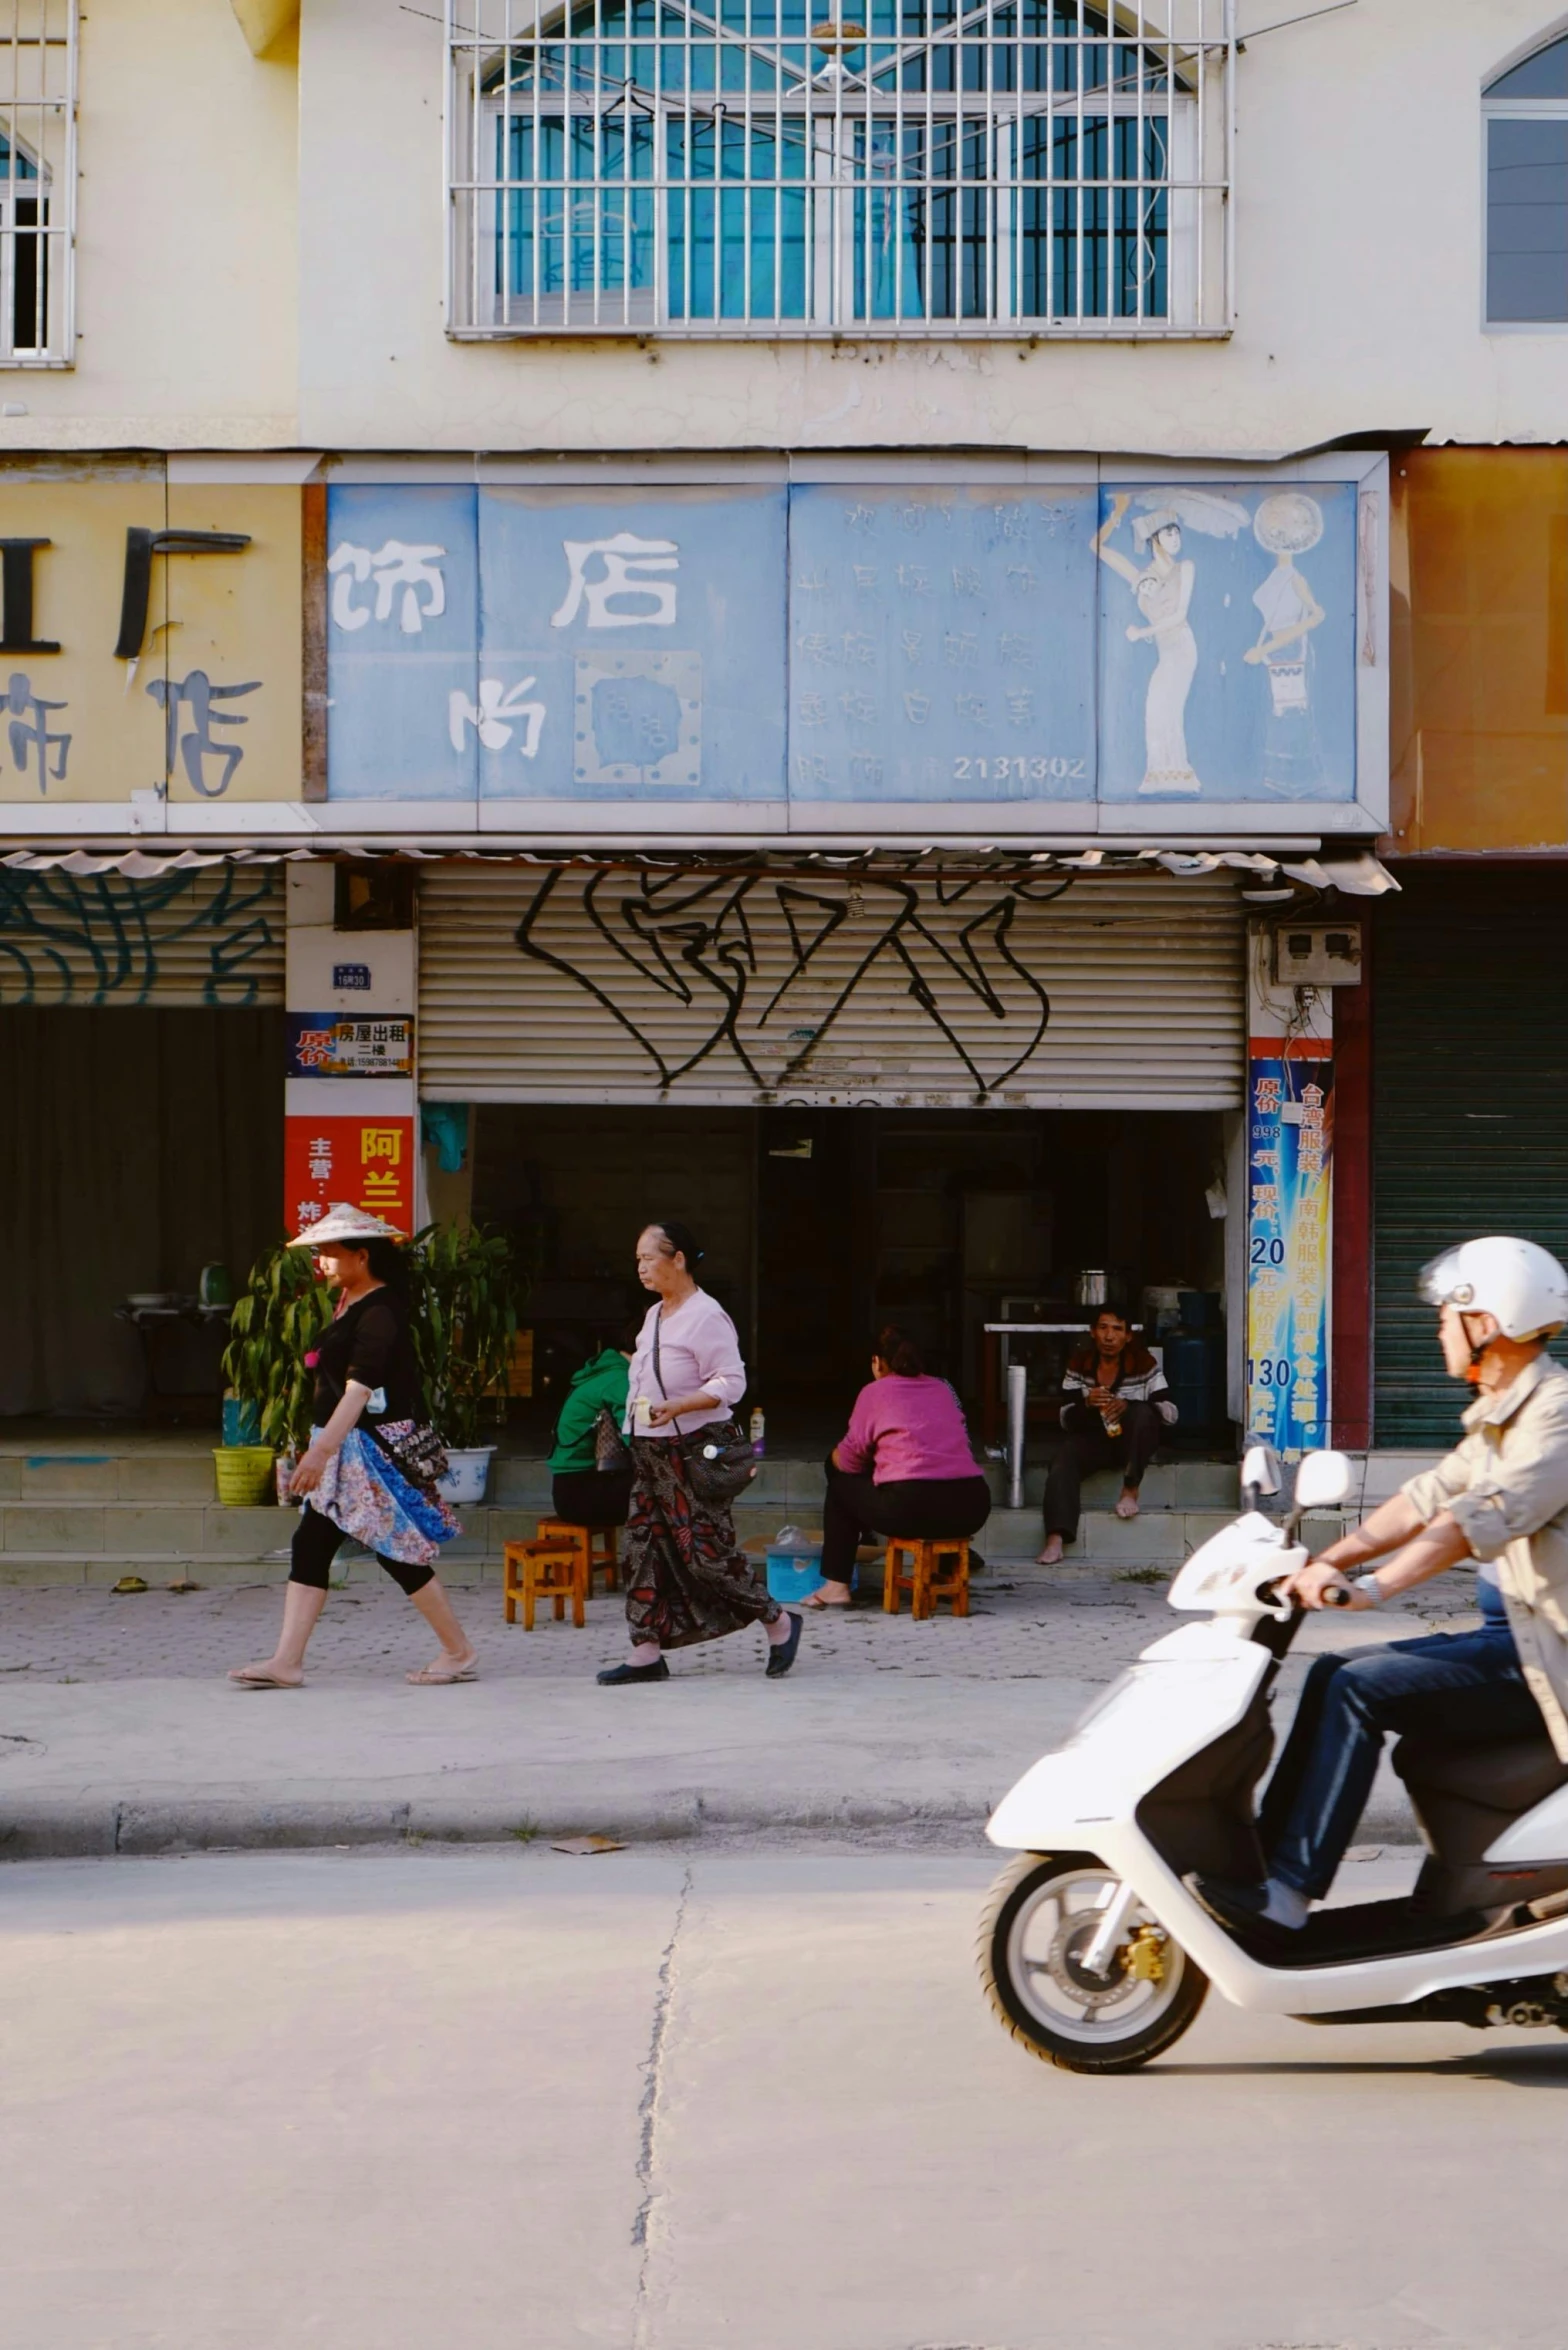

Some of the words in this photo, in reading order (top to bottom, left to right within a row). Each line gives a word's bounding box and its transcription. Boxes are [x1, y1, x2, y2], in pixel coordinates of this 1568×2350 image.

[327, 532, 680, 634] 饰店
[953, 755, 1088, 782] 2131302
[339, 1024, 406, 1043] 房屋出租
[296, 1030, 335, 1067] 原价
[357, 1043, 387, 1056] 二楼
